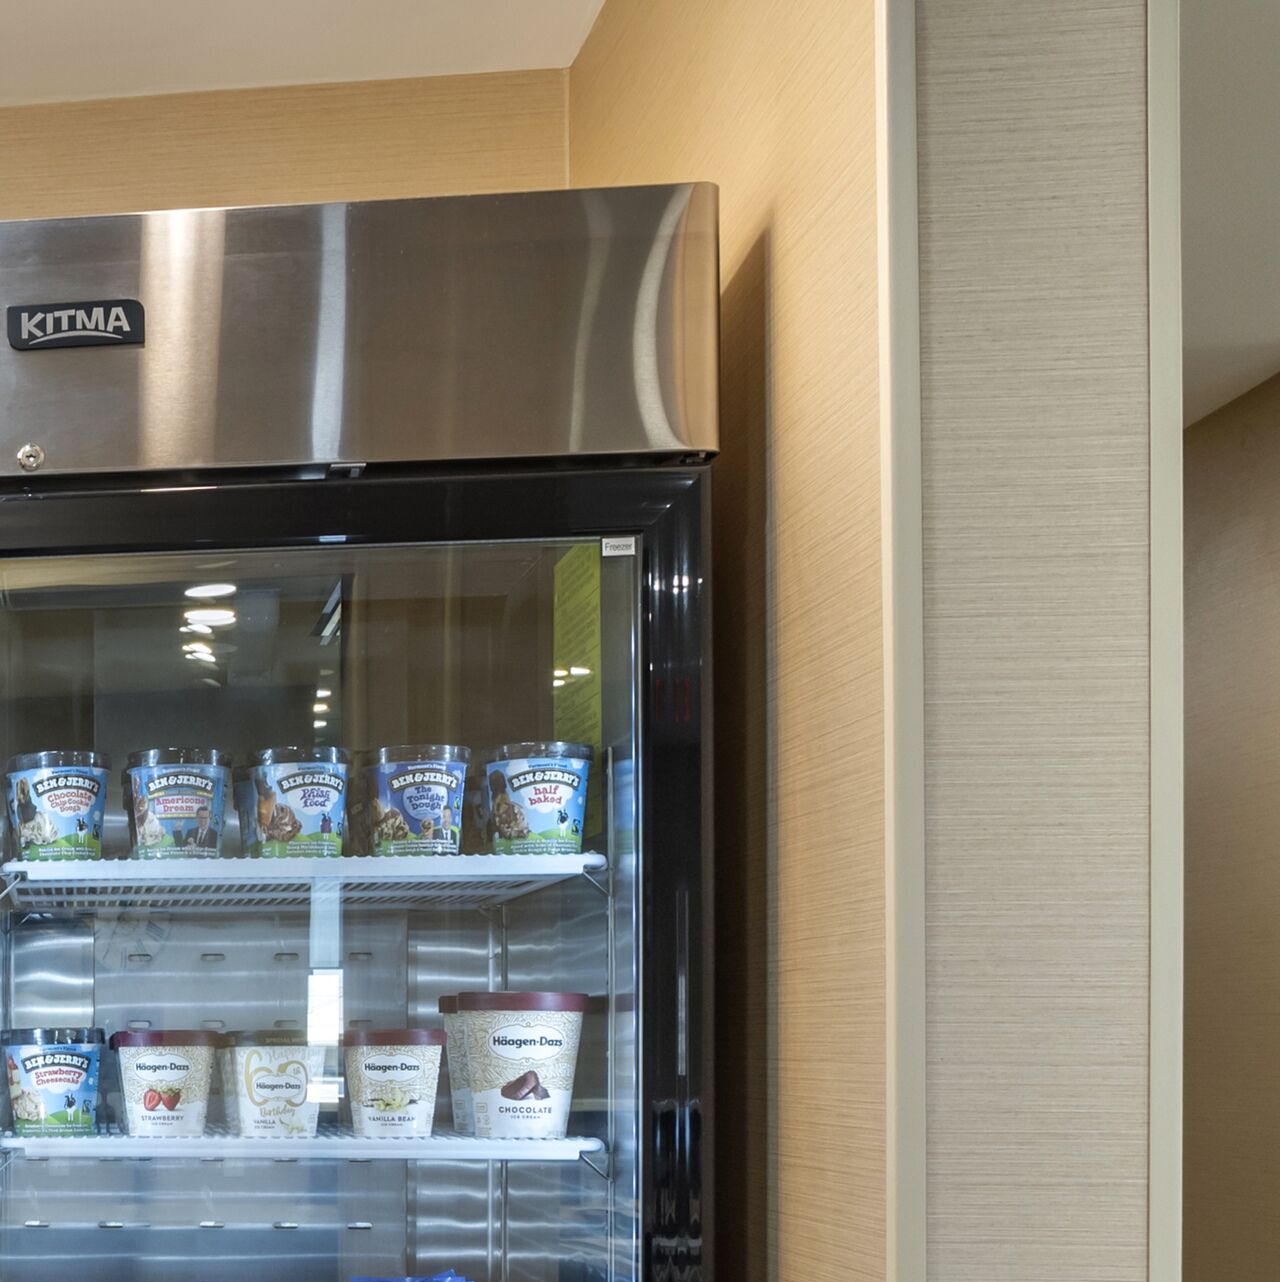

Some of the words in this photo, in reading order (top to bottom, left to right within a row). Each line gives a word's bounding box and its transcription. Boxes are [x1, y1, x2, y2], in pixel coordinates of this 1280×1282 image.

[21, 307, 130, 339] KITMA
[605, 543, 632, 551] Freezer
[533, 786, 559, 796] half
[47, 790, 92, 803] Chocolate
[528, 795, 562, 806] baked
[163, 804, 194, 813] Dream
[493, 1035, 563, 1049] Häagen-Dazs
[135, 1062, 190, 1072] Häagen-Dazs
[364, 1062, 420, 1073] Häagen-Dazs
[35, 1069, 83, 1079] Strawberry
[35, 1077, 80, 1086] Cheesecake
[498, 1106, 552, 1114] CHOCOLATE
